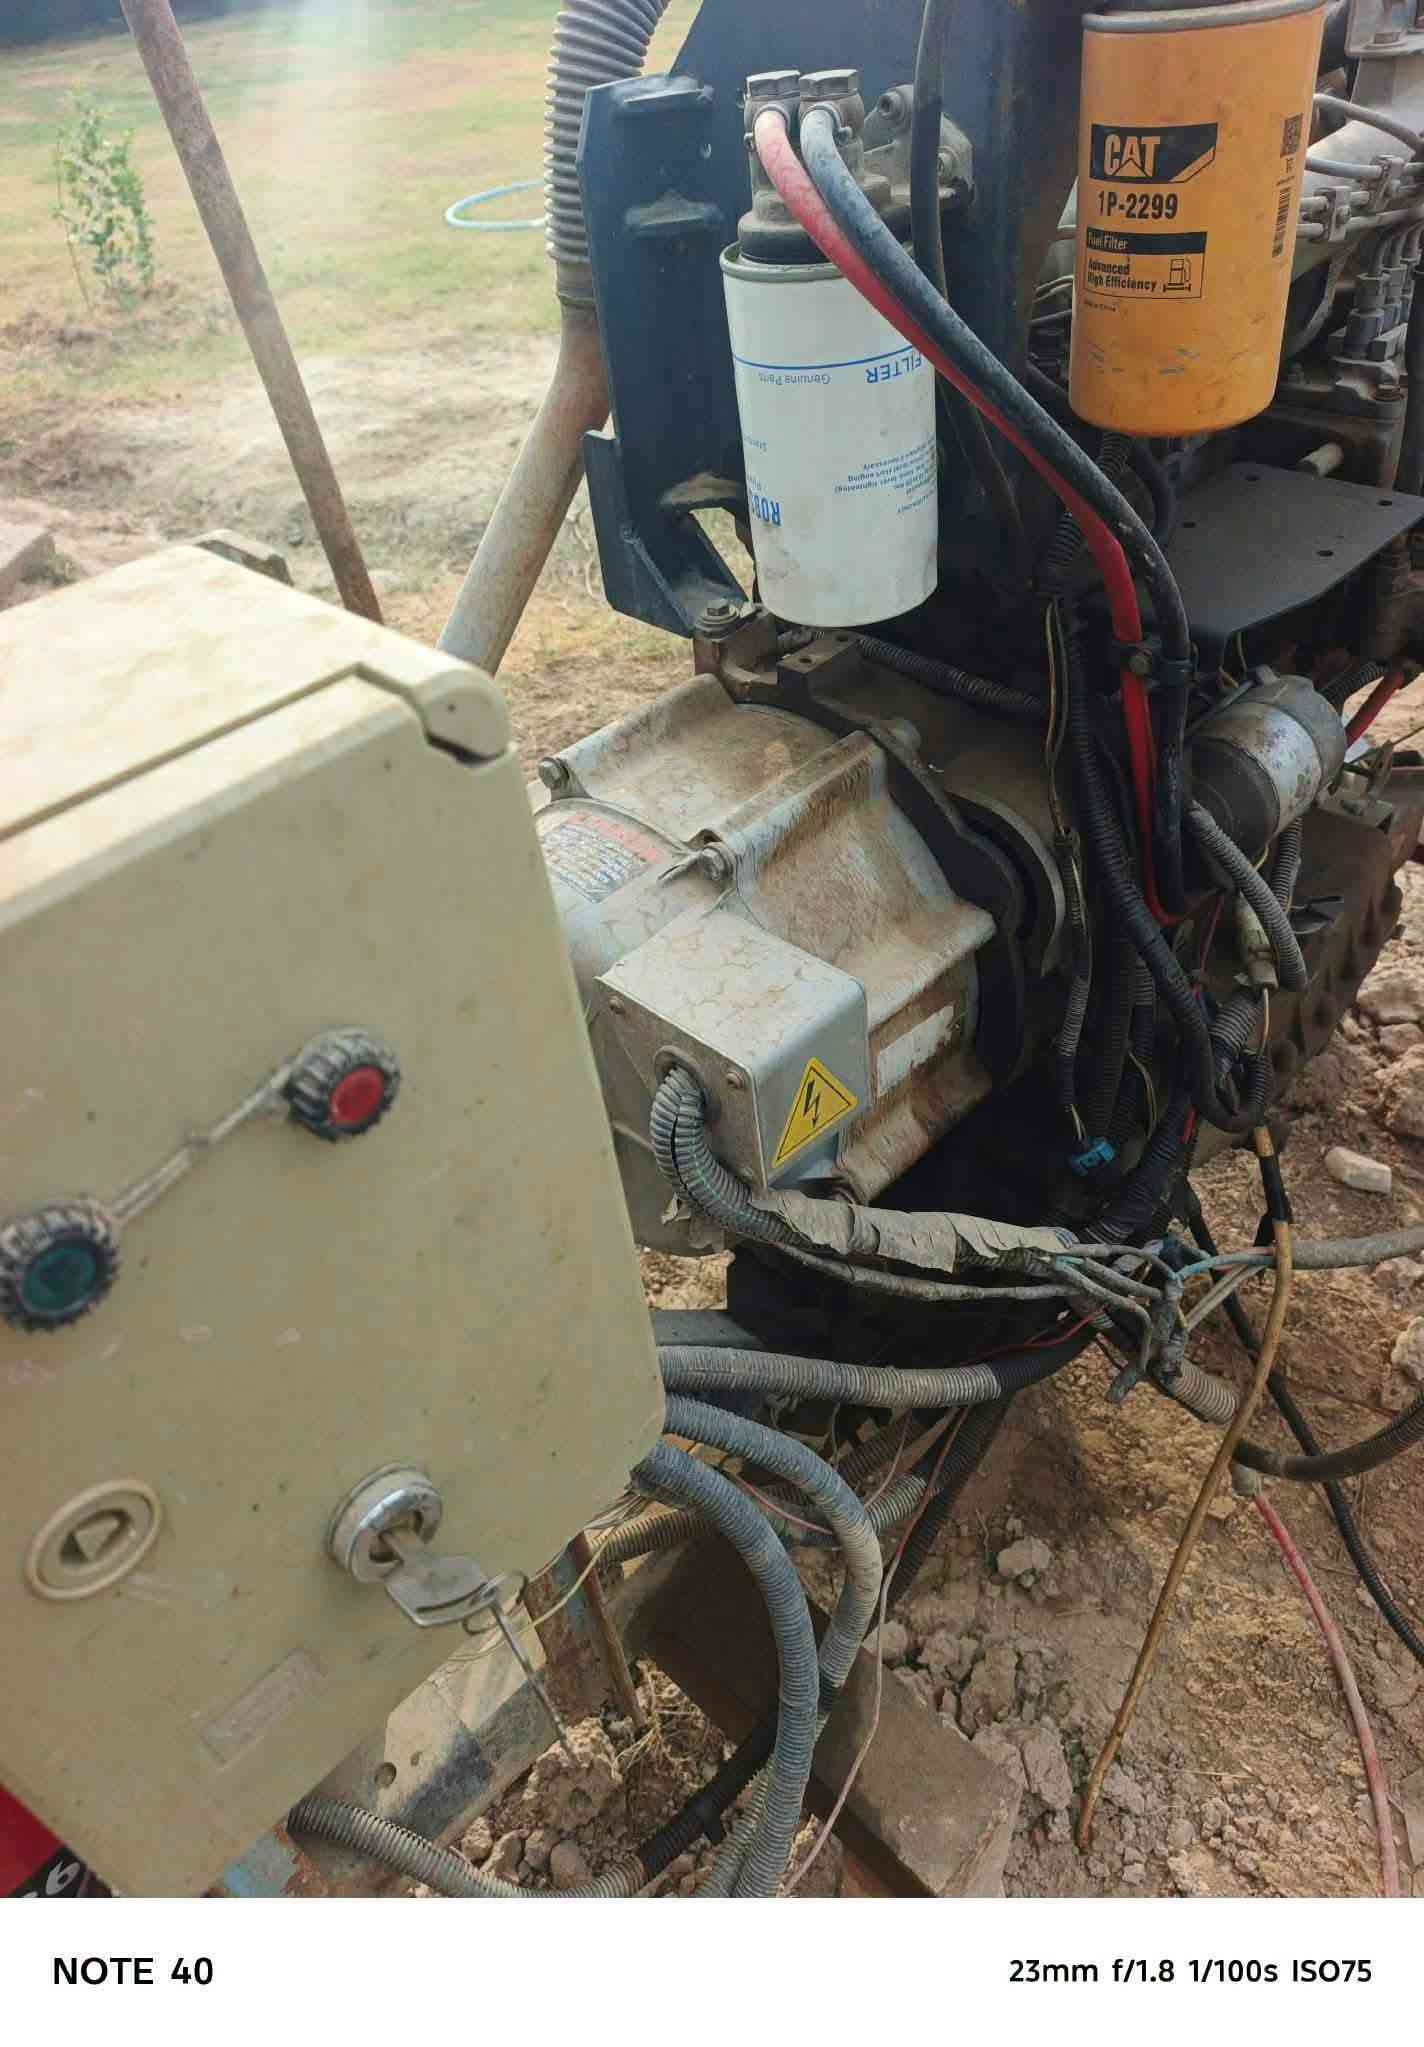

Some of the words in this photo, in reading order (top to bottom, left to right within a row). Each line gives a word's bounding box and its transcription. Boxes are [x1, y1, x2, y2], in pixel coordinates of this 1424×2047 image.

[1104, 134, 1161, 177] CAT
[1098, 191, 1179, 220] 1P-2299
[1104, 234, 1129, 250] Filter
[1088, 258, 1131, 275] Advanced
[1087, 272, 1104, 287] High
[1105, 275, 1158, 292] Efficiency
[865, 352, 922, 384] FILTER
[785, 373, 832, 385] Genuine
